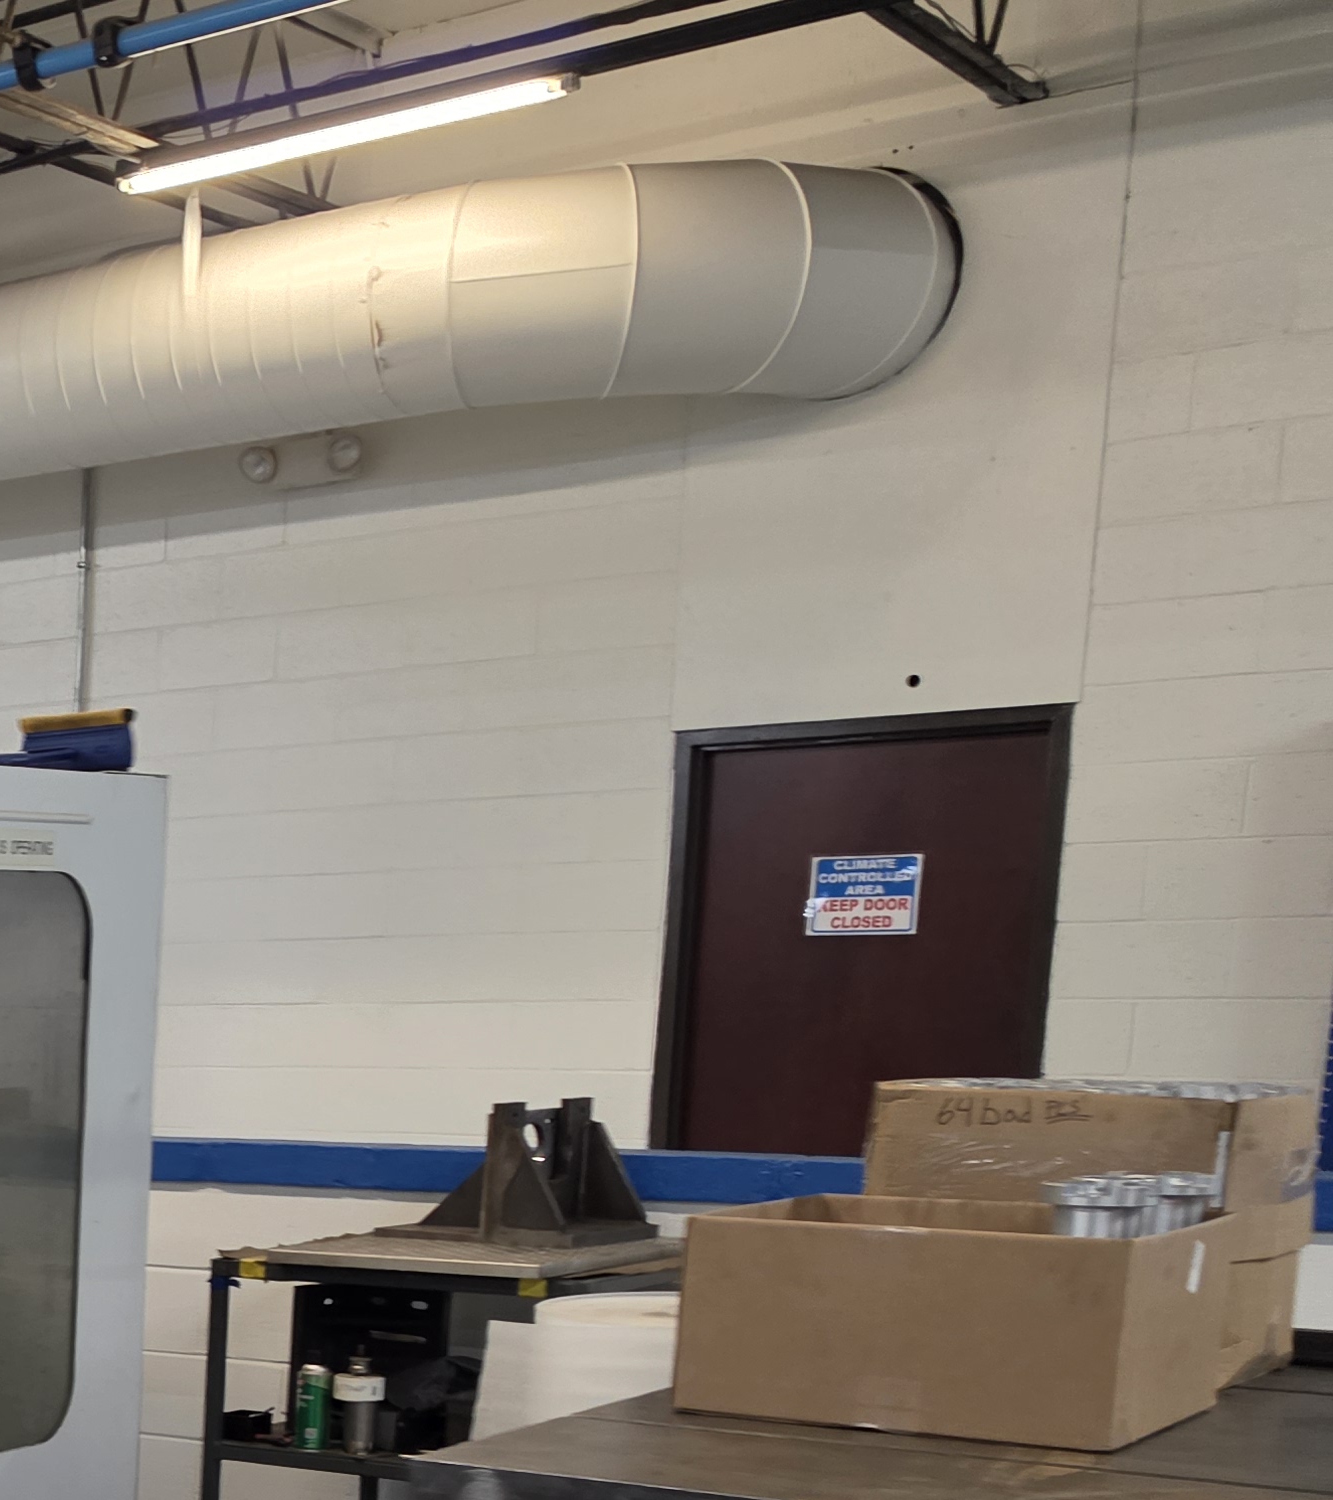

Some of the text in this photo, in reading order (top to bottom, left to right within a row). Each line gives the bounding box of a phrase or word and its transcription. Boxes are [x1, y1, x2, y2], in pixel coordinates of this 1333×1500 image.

[833, 859, 897, 870] CLIMATE
[818, 872, 913, 883] CONTROLLED
[845, 885, 884, 895] AREA
[817, 898, 909, 913] KEEP DOOR
[830, 916, 893, 929] CLOSED
[979, 1096, 1032, 1126] bad
